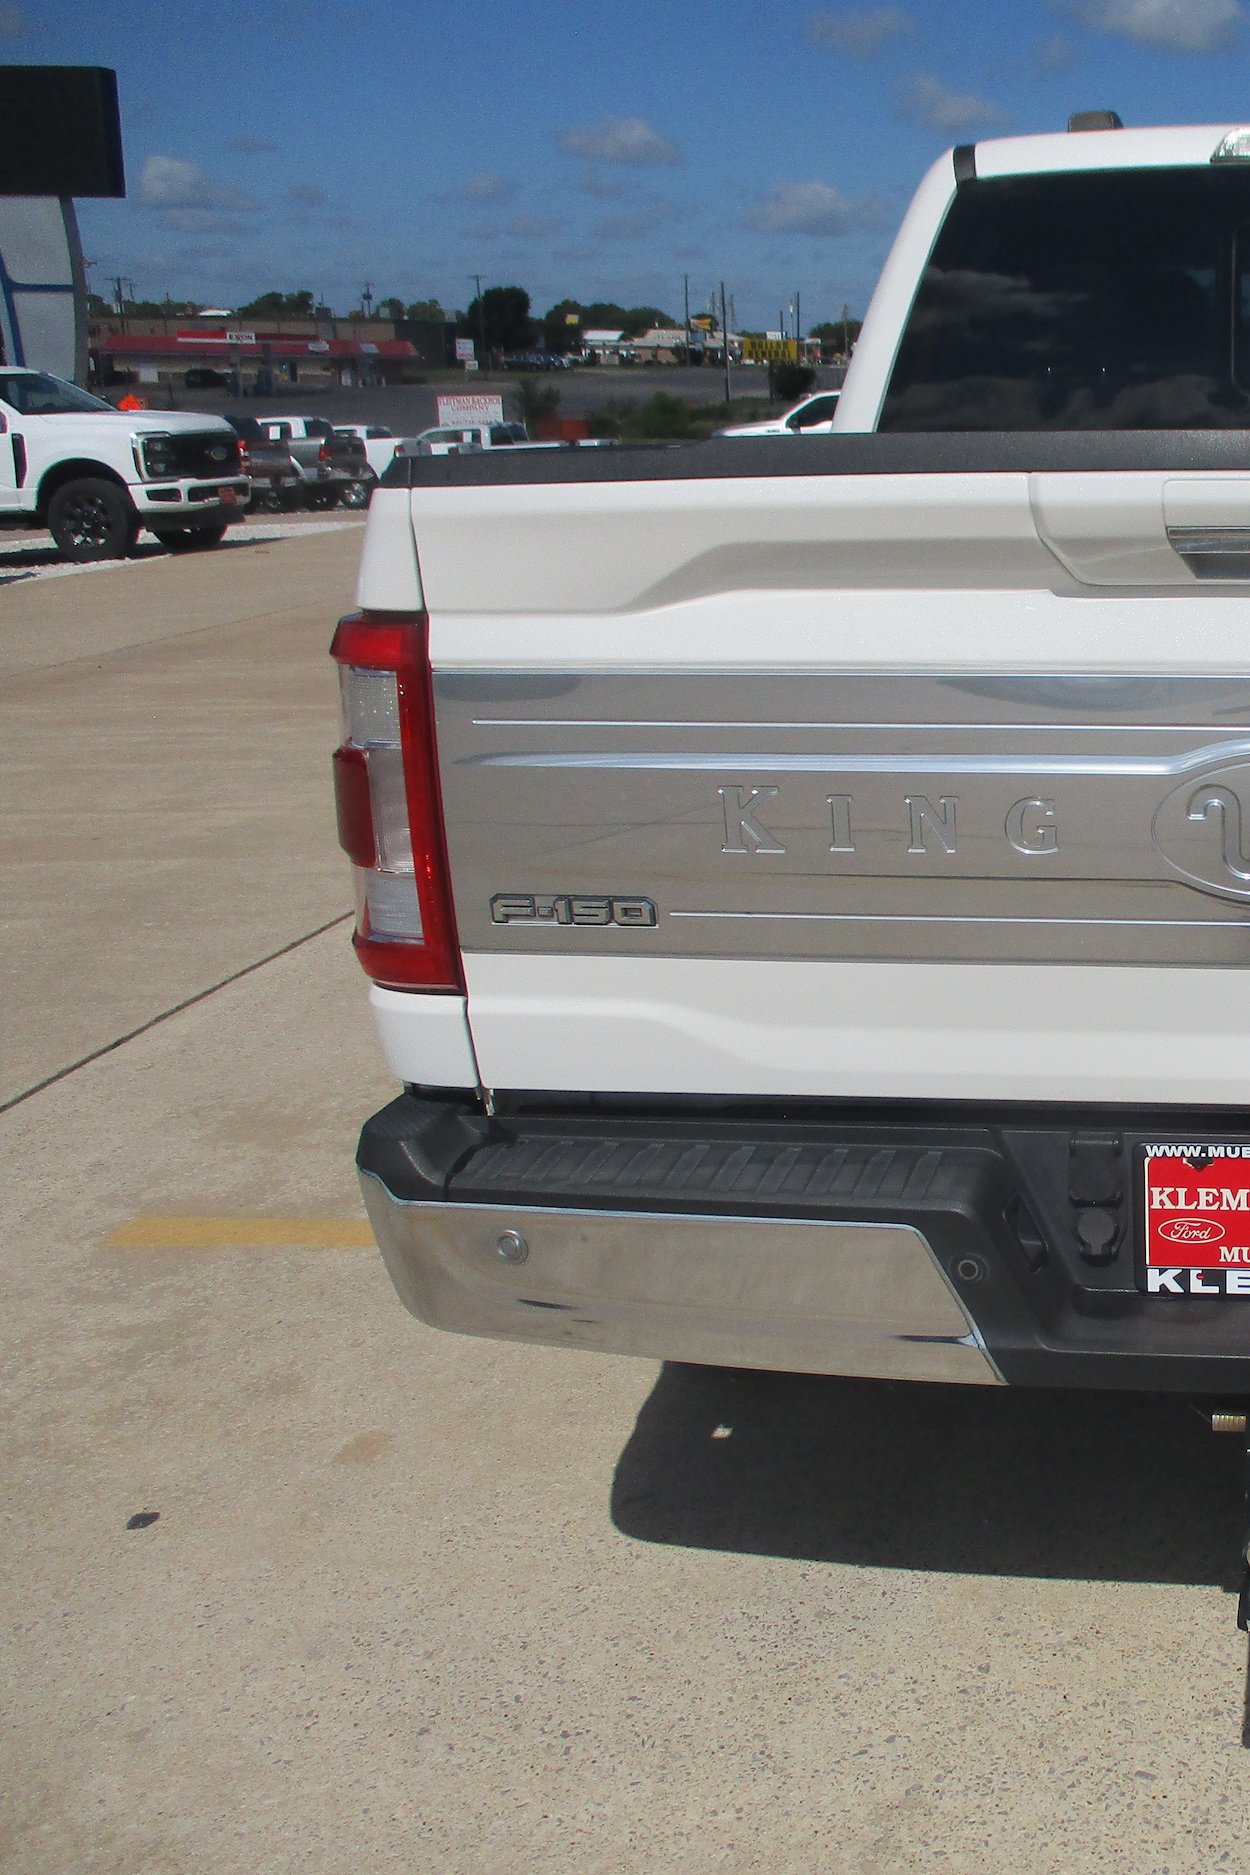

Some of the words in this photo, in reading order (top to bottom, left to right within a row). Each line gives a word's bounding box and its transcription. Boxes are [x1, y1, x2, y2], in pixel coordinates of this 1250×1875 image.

[717, 785, 1058, 855] KING
[490, 893, 659, 928] F-150
[1170, 1221, 1211, 1240] Ford
